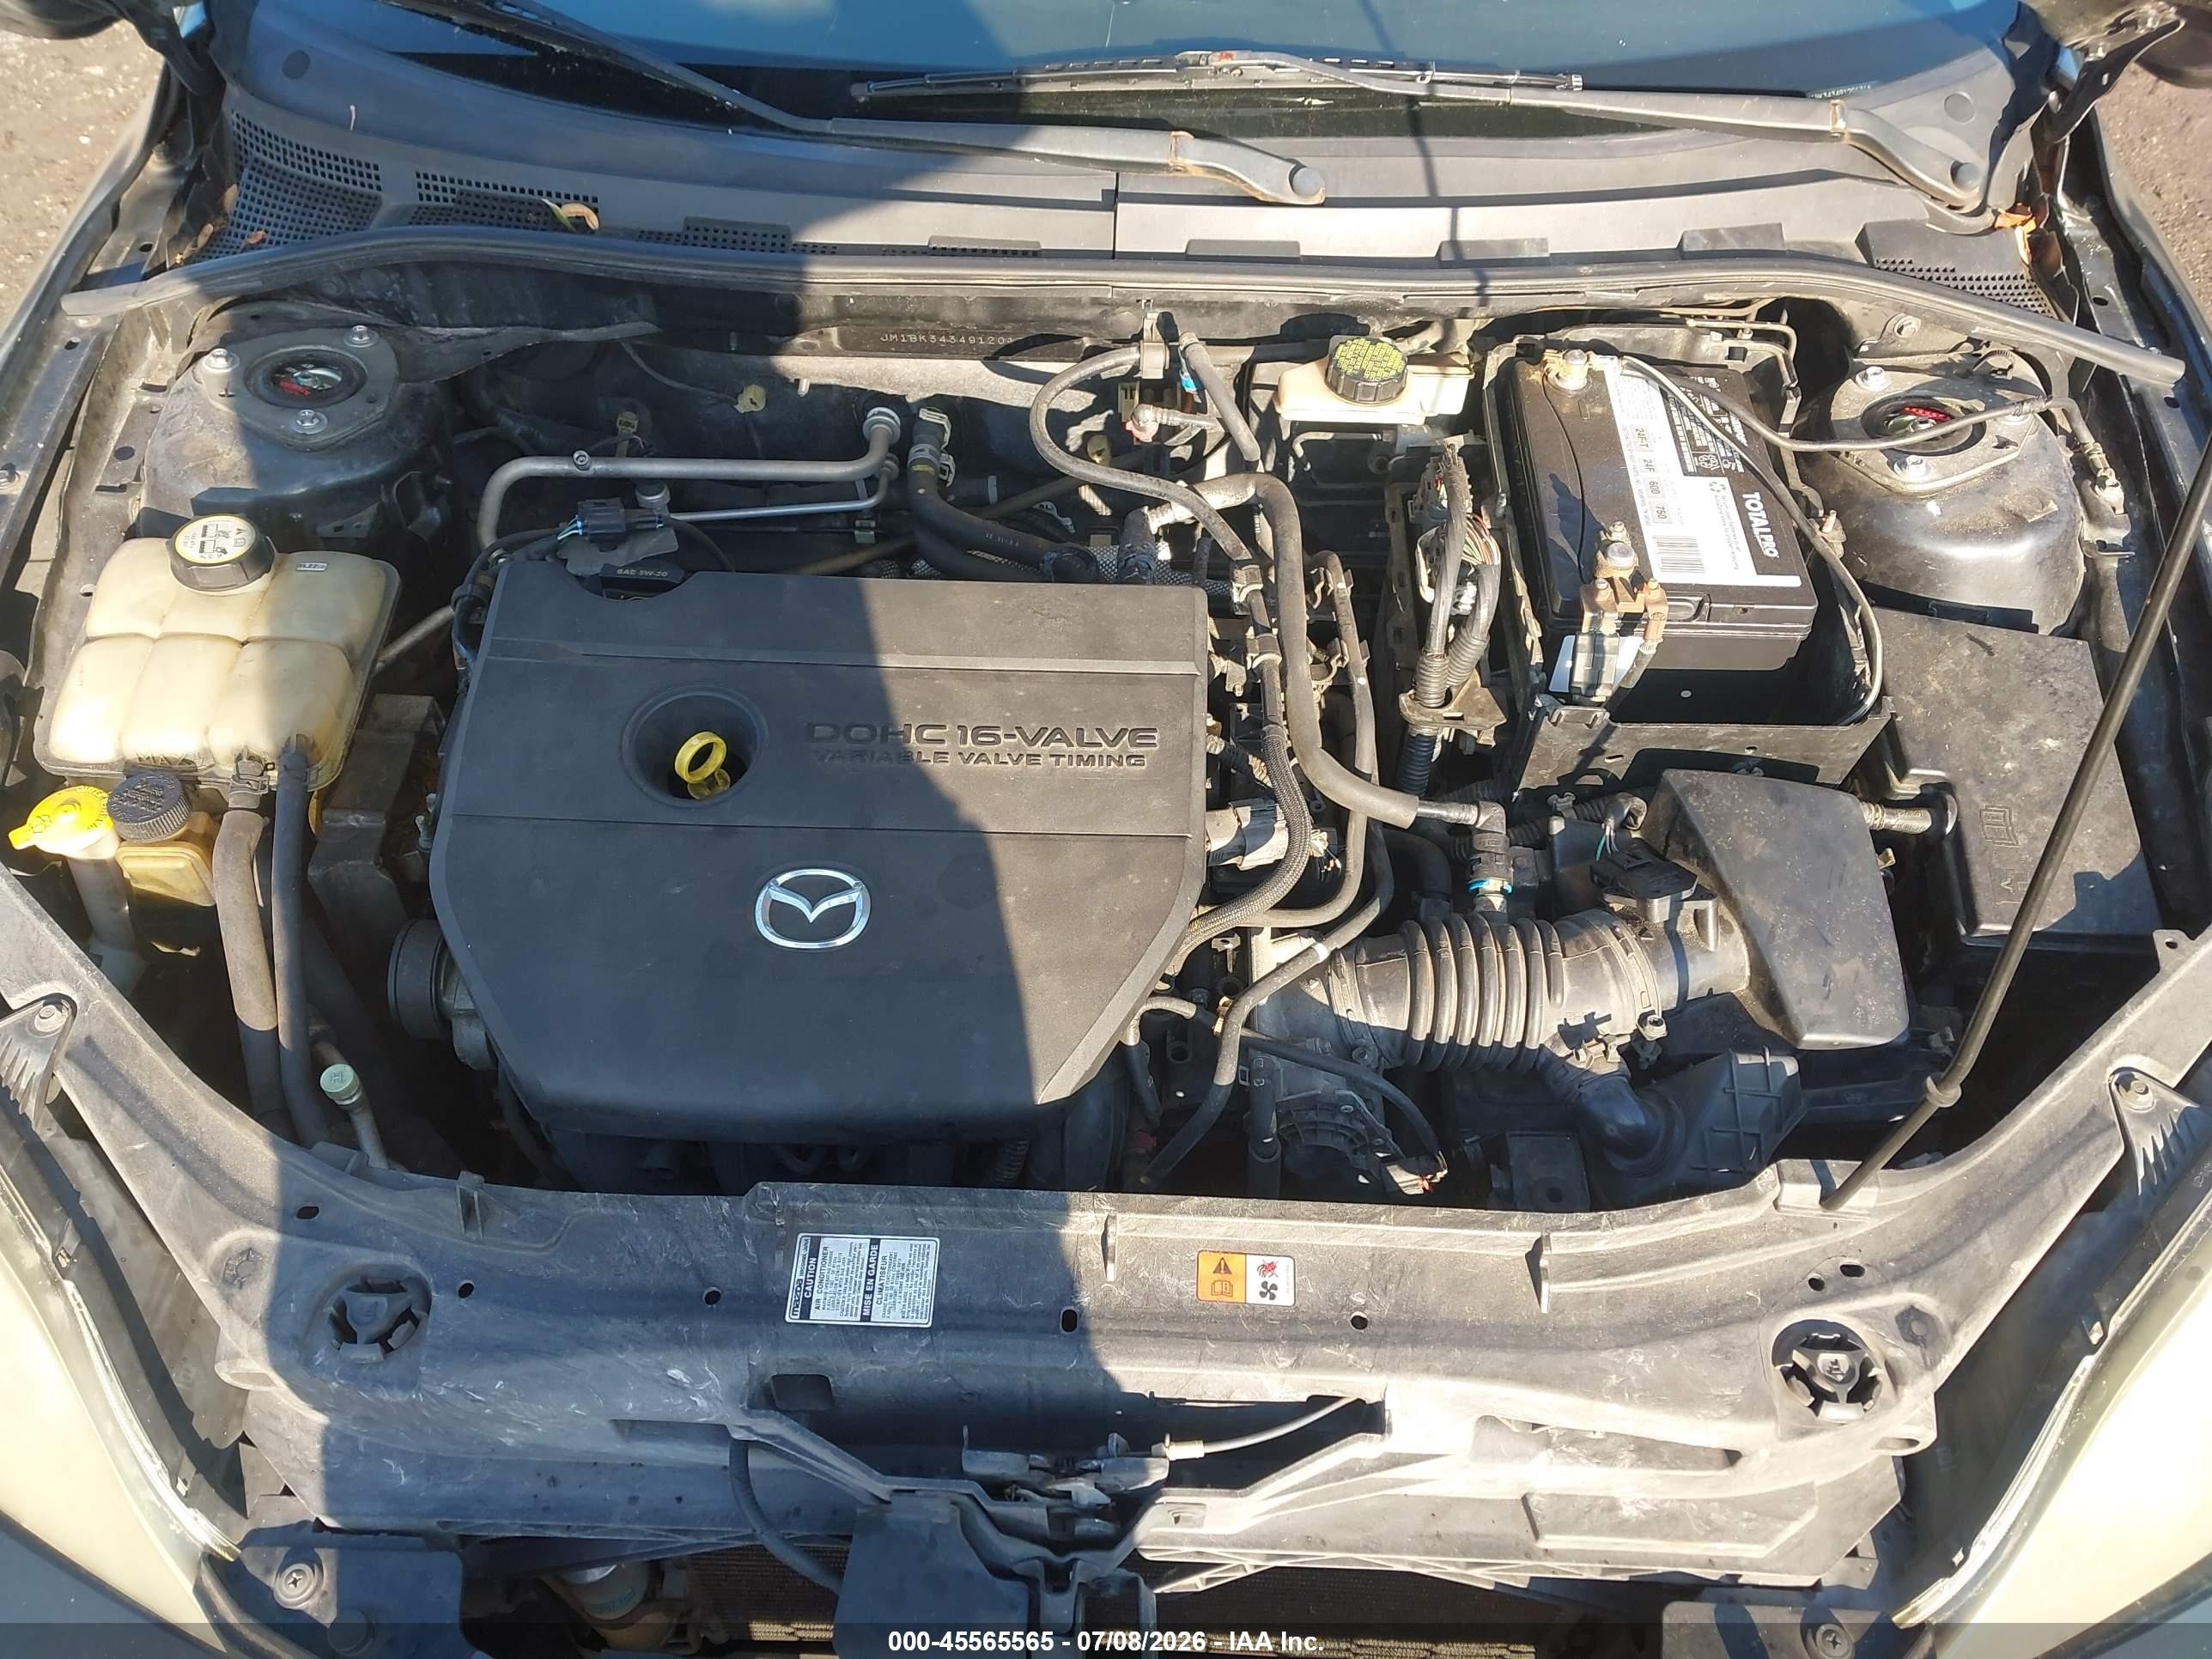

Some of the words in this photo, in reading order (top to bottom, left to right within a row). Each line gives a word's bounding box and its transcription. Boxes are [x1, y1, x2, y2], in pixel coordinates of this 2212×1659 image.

[1649, 481, 1661, 495] 600
[1656, 506, 1668, 520] 750
[806, 722, 947, 745] DOHC
[957, 725, 1159, 749] 16-VALVE
[814, 750, 950, 764] VARIABLE
[957, 752, 1042, 766] VALVE
[1049, 753, 1146, 768] TIMING
[817, 1246, 829, 1294] CONDITIONER
[868, 1244, 878, 1276] GARDE
[804, 1257, 817, 1298] CAUTION
[866, 1279, 874, 1291] EN
[876, 1255, 888, 1305] CLIMATISEUR
[863, 1294, 872, 1316] MISE
